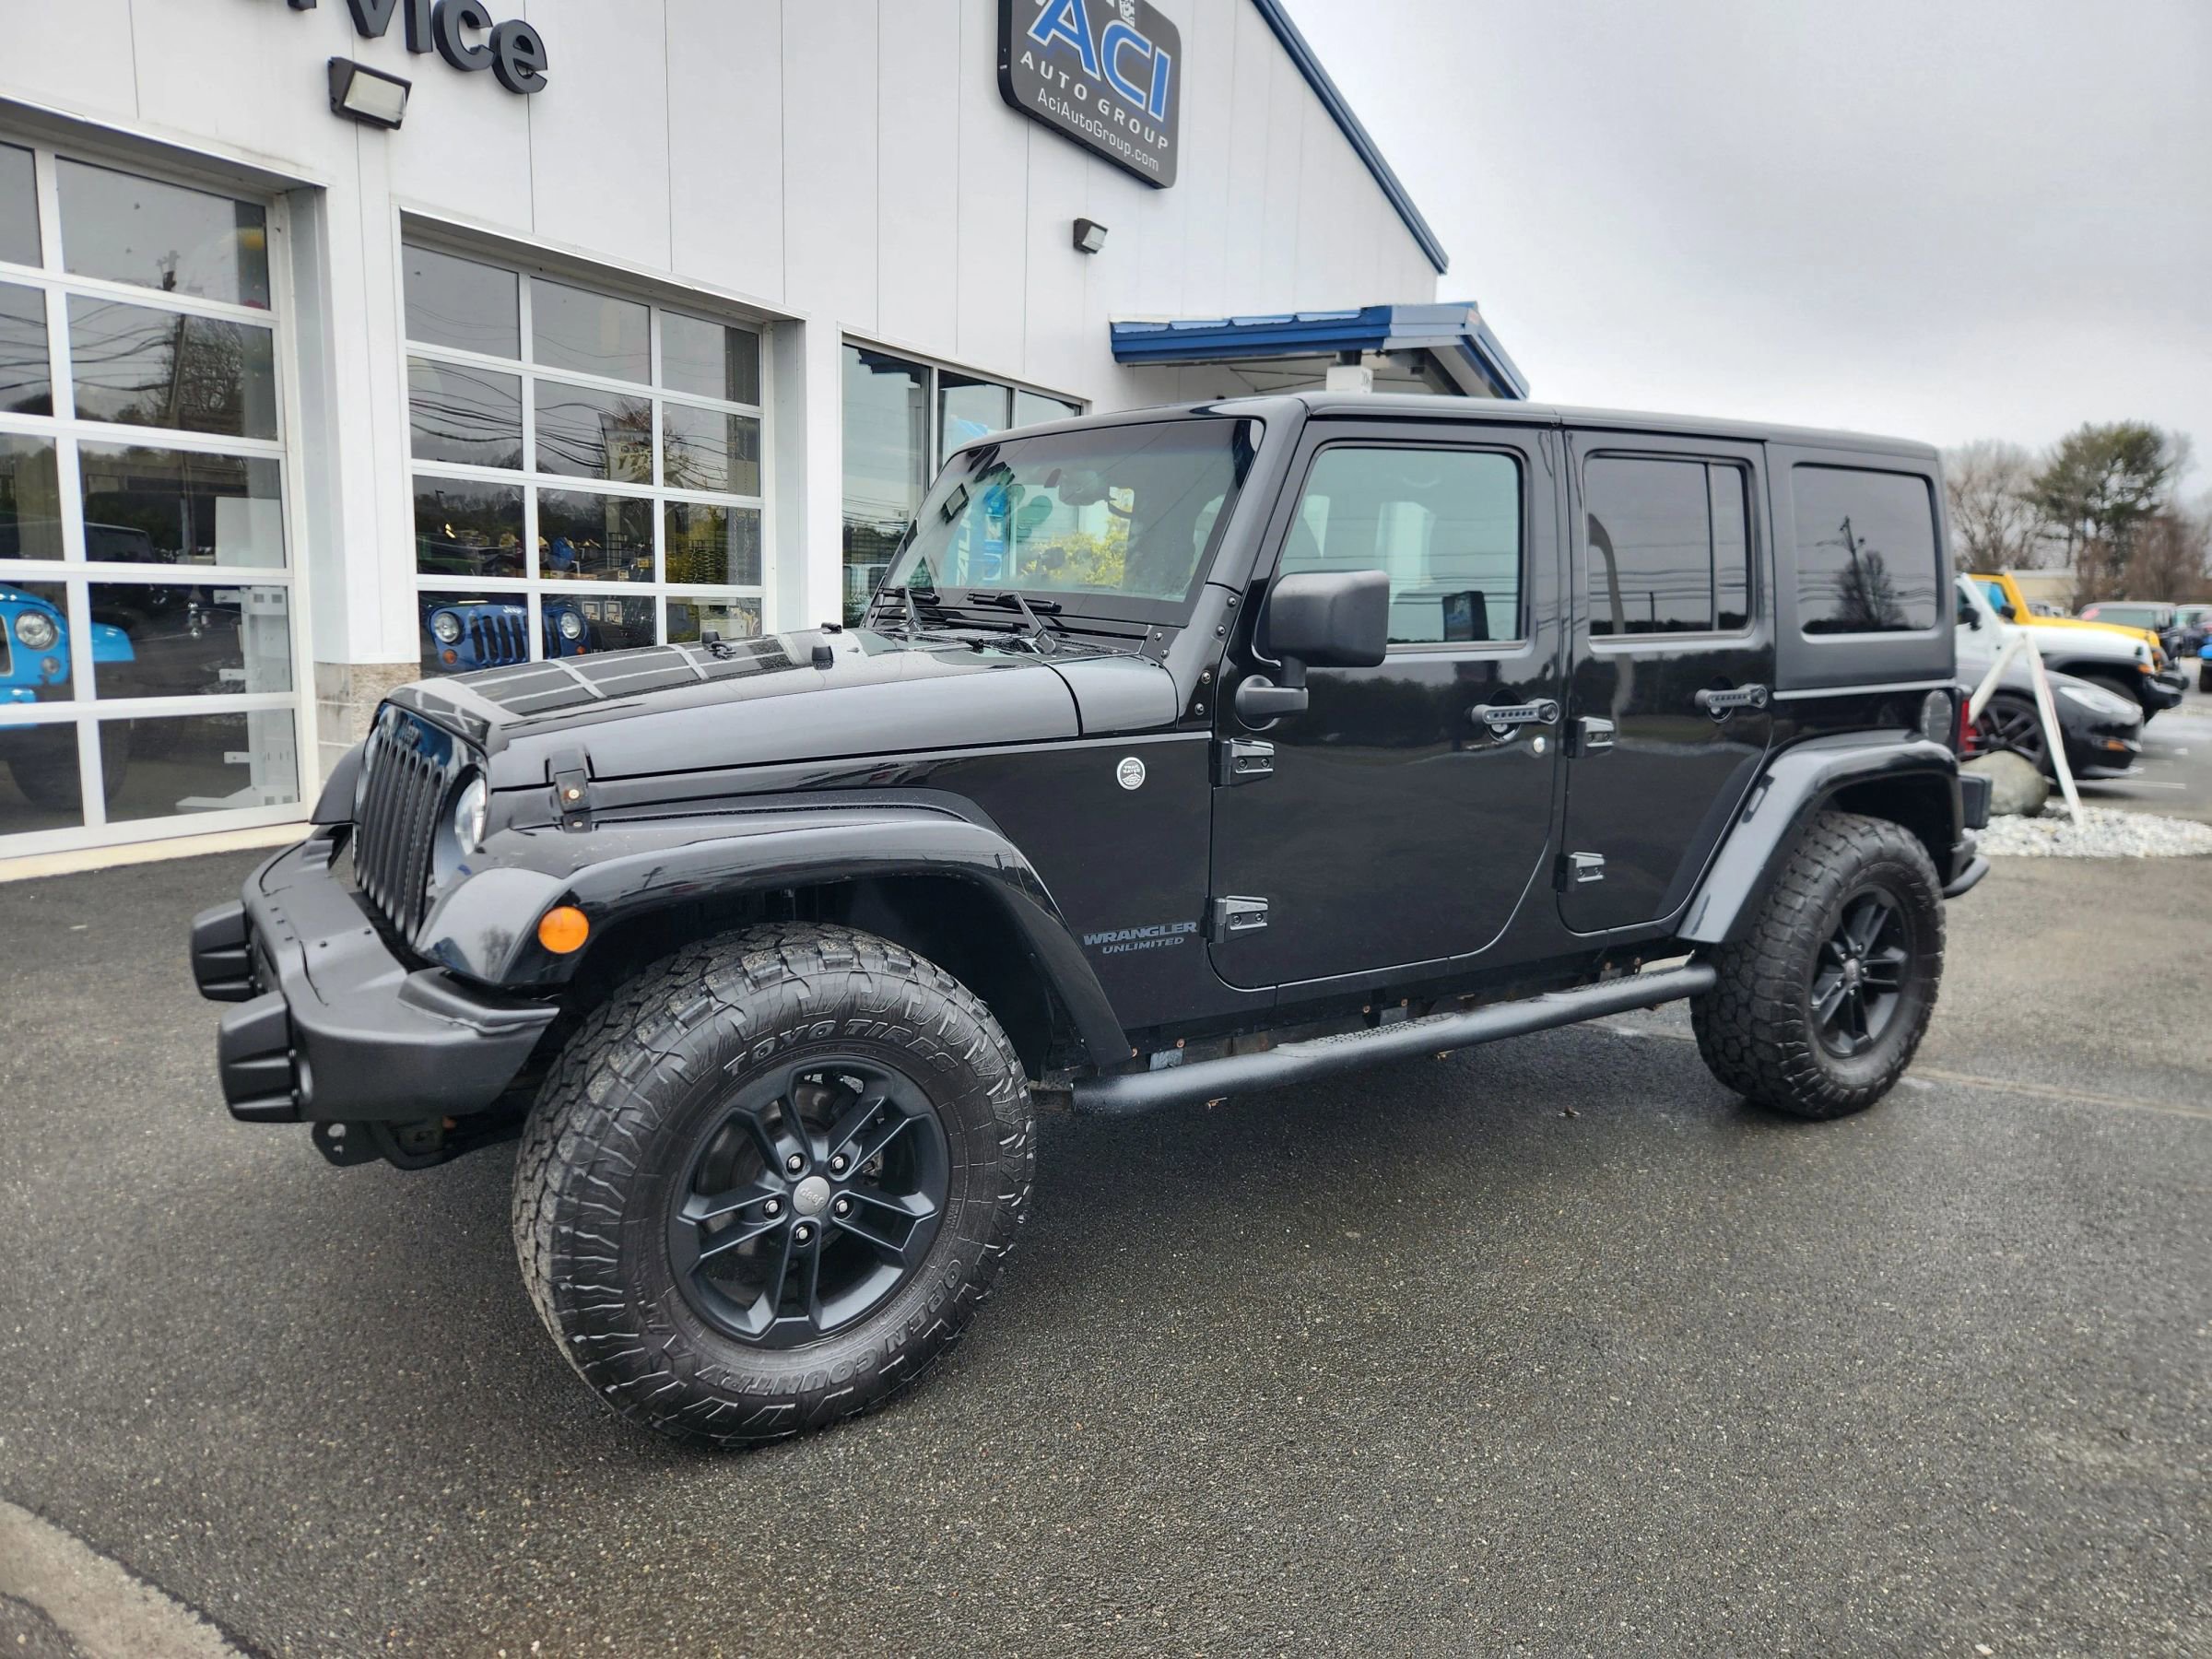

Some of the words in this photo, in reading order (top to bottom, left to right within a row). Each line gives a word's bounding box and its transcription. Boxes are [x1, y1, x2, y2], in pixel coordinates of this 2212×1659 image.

[288, 0, 548, 94] vice
[1027, 0, 1171, 123] ACI
[1019, 51, 1088, 101] AUTO
[1098, 98, 1169, 150] GROUP
[1037, 88, 1159, 172] AciAutoGroup.com
[1083, 921, 1198, 946] WRANGLER
[1102, 936, 1185, 955] UNLIMITED
[723, 1019, 837, 1077] TOYO
[844, 1019, 959, 1073] TIRES
[799, 1187, 825, 1206] Jeep
[885, 1259, 962, 1357] OPEN
[694, 1348, 877, 1395] COUNTRY
